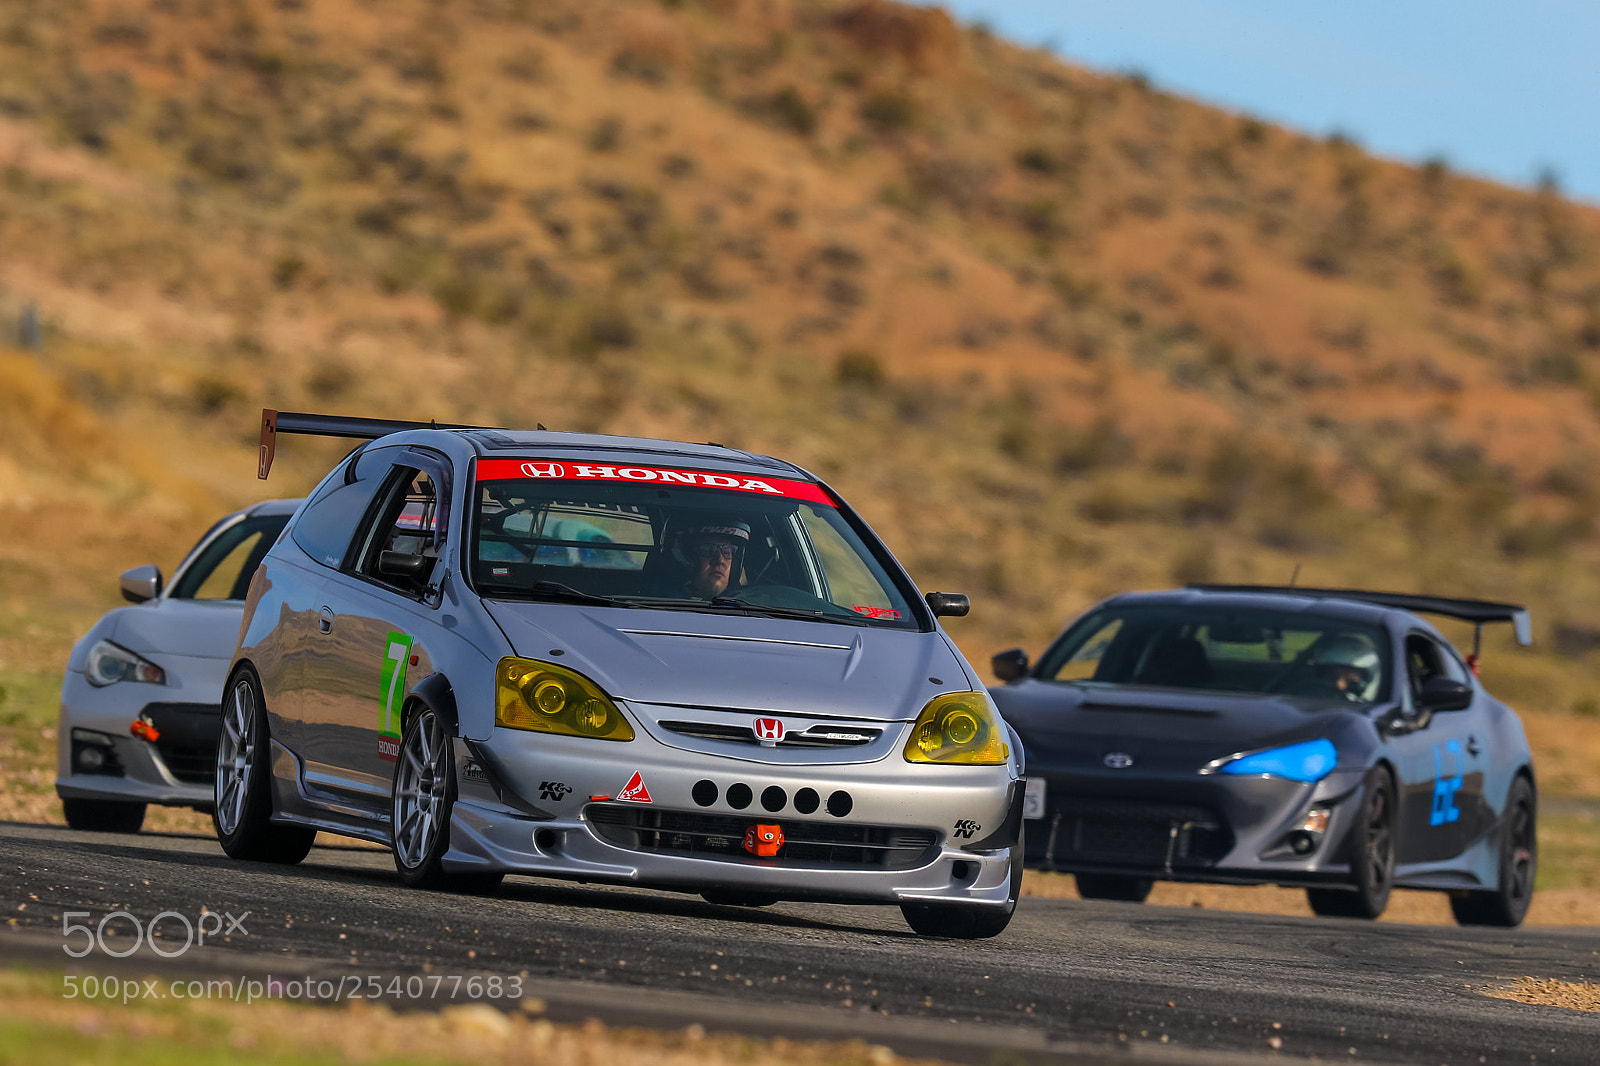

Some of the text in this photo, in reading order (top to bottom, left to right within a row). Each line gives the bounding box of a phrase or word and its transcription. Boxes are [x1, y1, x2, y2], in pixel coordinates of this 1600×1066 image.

[572, 465, 784, 494] HONDA
[386, 642, 407, 731] 7
[538, 781, 572, 801] K&N
[953, 820, 981, 838] K&N
